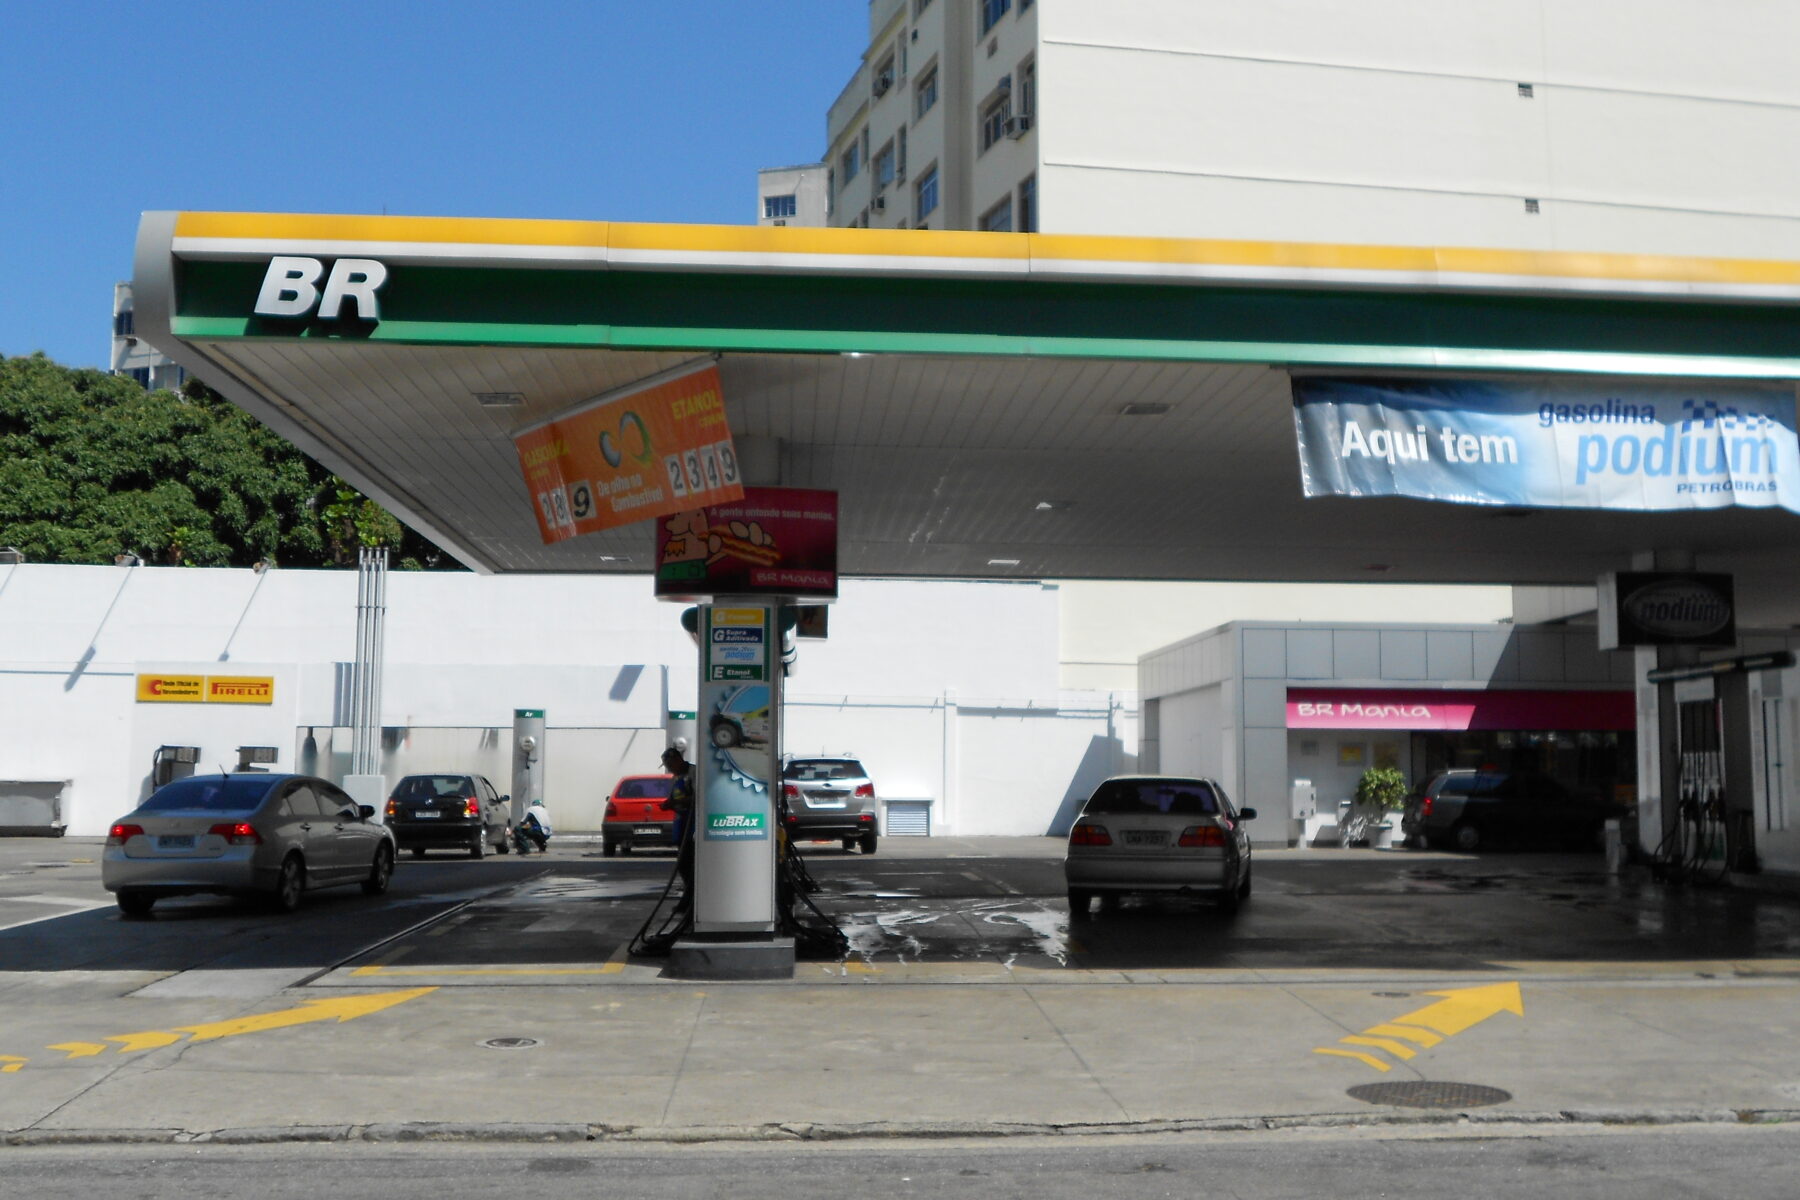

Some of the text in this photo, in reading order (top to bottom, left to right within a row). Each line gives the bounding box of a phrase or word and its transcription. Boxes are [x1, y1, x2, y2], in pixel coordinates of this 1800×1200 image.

[254, 256, 387, 318] BR
[672, 390, 720, 420] ETANOL
[1539, 399, 1656, 427] gasolina
[1341, 421, 1518, 464] Aqui tem
[1576, 424, 1778, 485] podium
[1677, 480, 1778, 494] PETROBRAS
[757, 572, 829, 585] BR Mania
[714, 629, 725, 641] G
[714, 666, 724, 679] E
[211, 682, 270, 696] PIRELLI
[1297, 703, 1432, 719] BR Mania
[713, 815, 759, 827] LUBRAX
